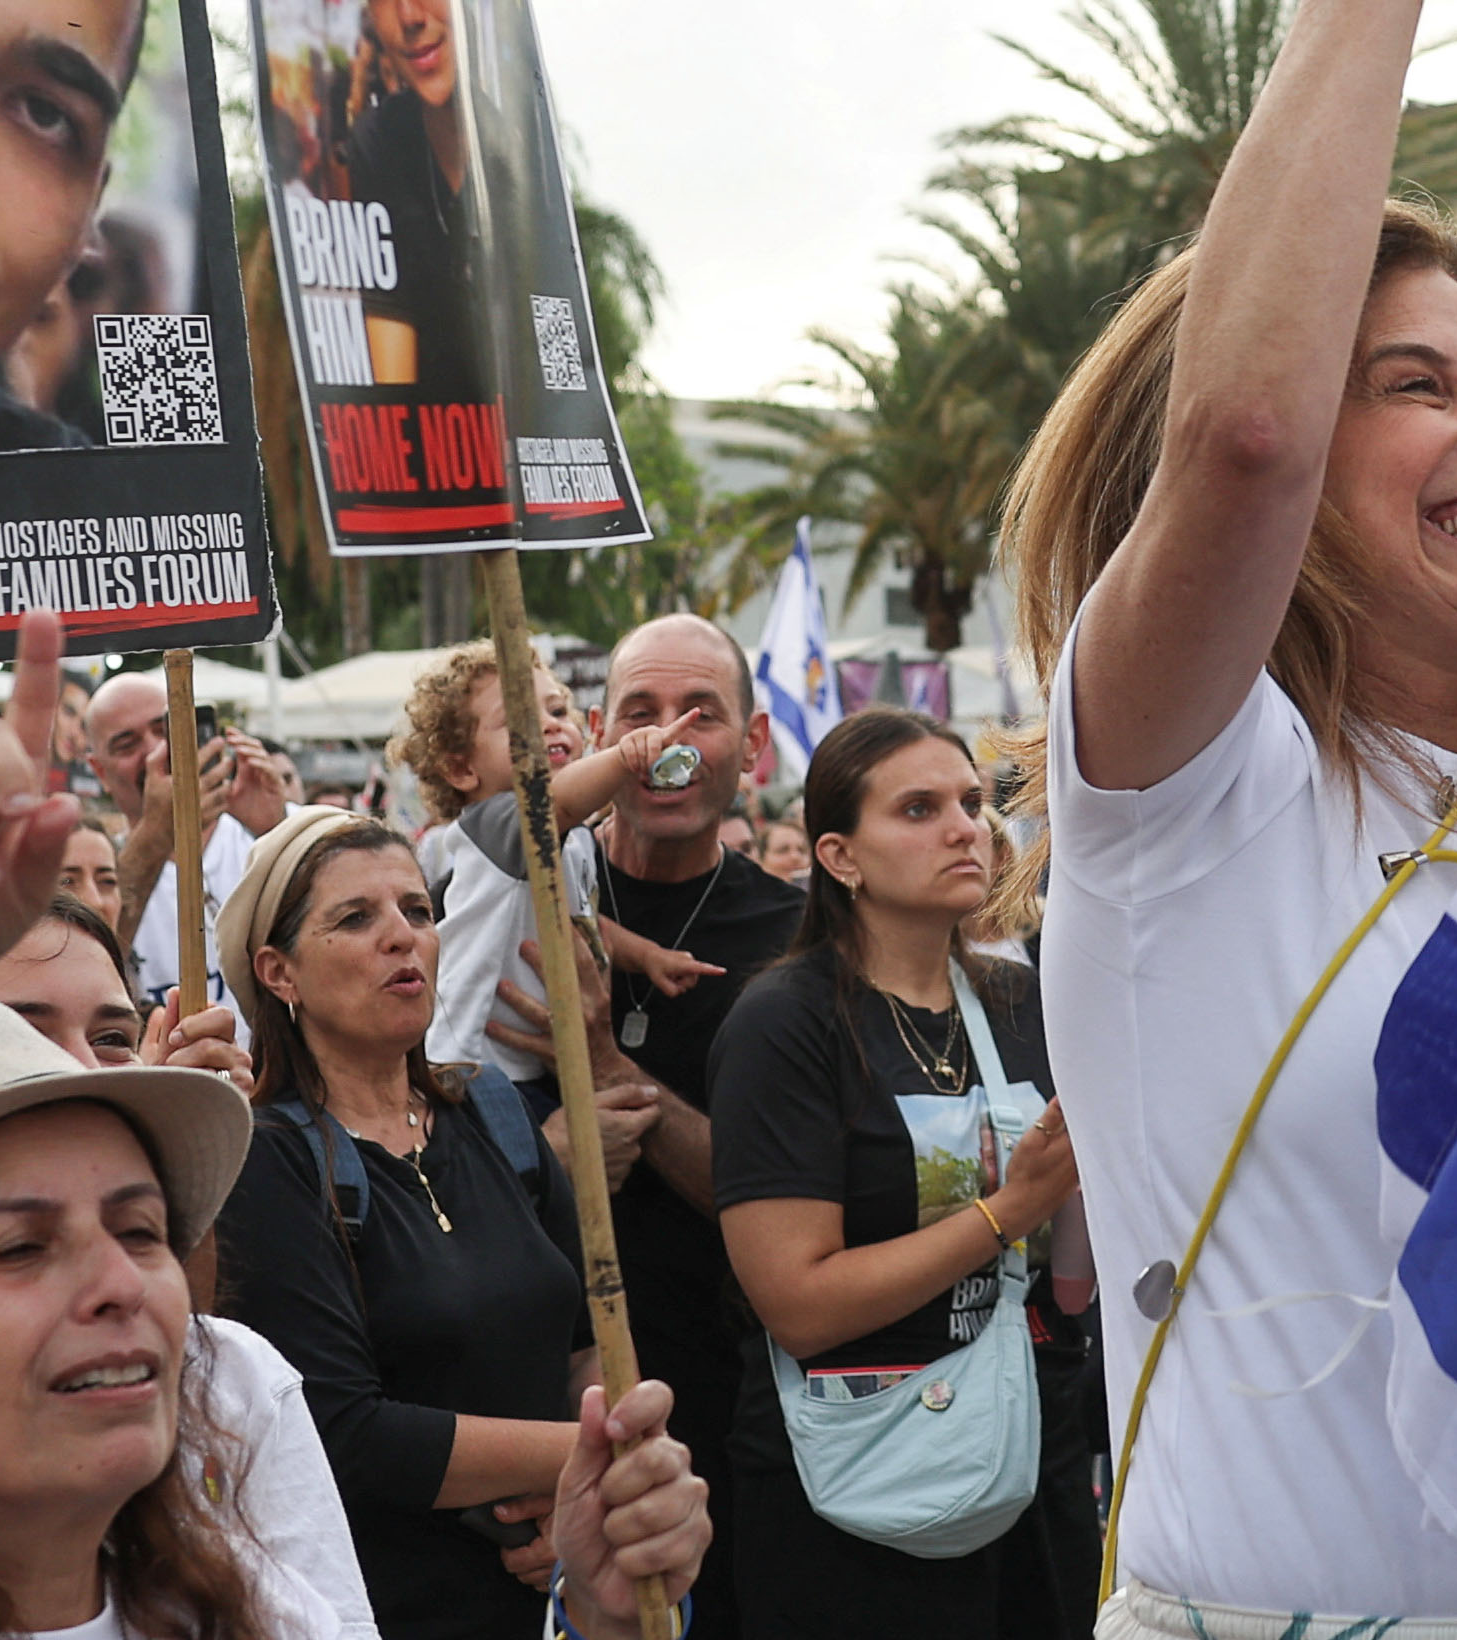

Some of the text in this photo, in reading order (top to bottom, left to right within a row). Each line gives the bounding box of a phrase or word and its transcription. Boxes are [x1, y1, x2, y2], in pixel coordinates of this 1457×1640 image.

[284, 195, 398, 291] BRING
[300, 288, 373, 387] HIM
[320, 404, 418, 493] HOME
[104, 517, 148, 554] AND
[151, 513, 244, 551] MISSING
[142, 550, 250, 612] FORUM
